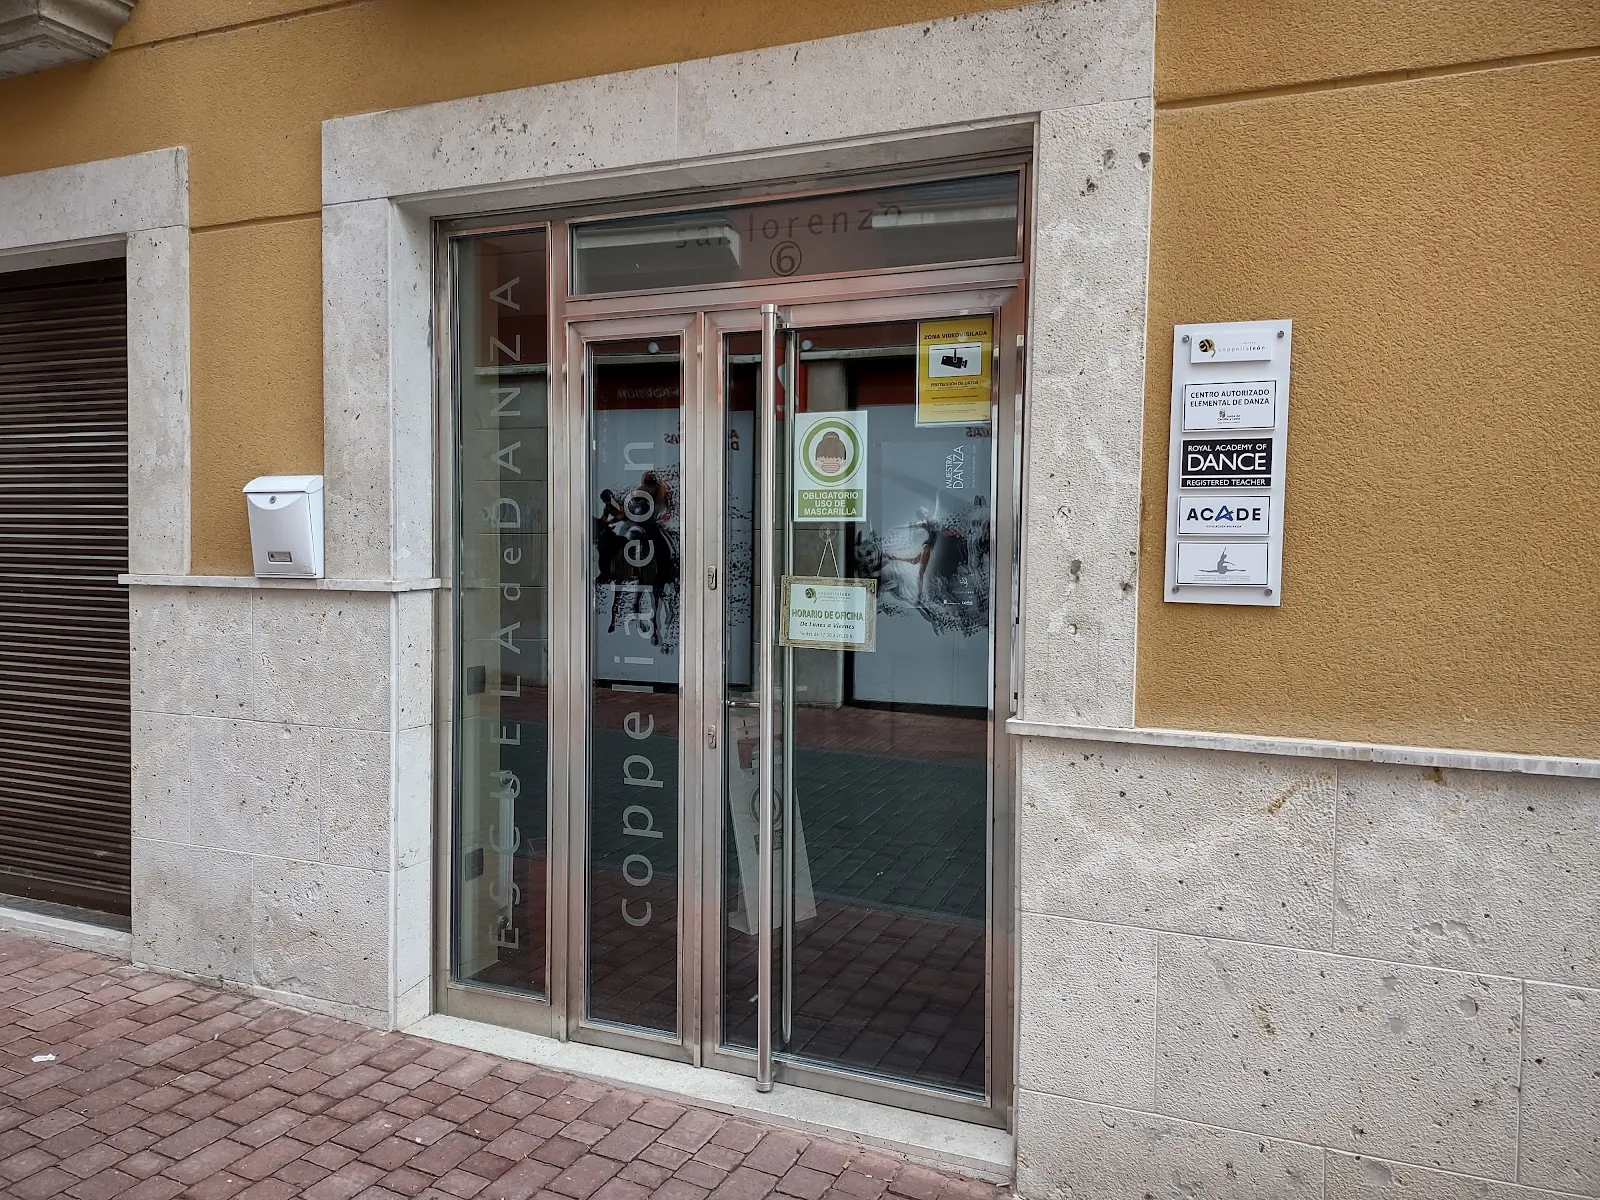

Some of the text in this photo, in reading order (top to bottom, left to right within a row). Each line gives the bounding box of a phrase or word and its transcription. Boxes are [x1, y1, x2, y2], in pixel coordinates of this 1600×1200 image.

[749, 204, 903, 242] lorenzo
[941, 330, 988, 339] VIDEOVIGILADA
[1190, 389, 1270, 399] CENTRO AUTORIZADO
[1190, 399, 1231, 408] ELEMENTAL
[1244, 398, 1270, 406] DANZA
[1256, 443, 1267, 451] OF
[953, 445, 964, 489] DANZA
[1187, 453, 1267, 472] DANCE
[1186, 479, 1230, 487] REGISTERED
[802, 491, 859, 500] OBLIGATORIO
[815, 500, 846, 508] USO DE
[804, 507, 857, 516] MASCARILLA
[1186, 505, 1261, 522] ACADE
[792, 609, 864, 621] HORARIO DE OFICINA
